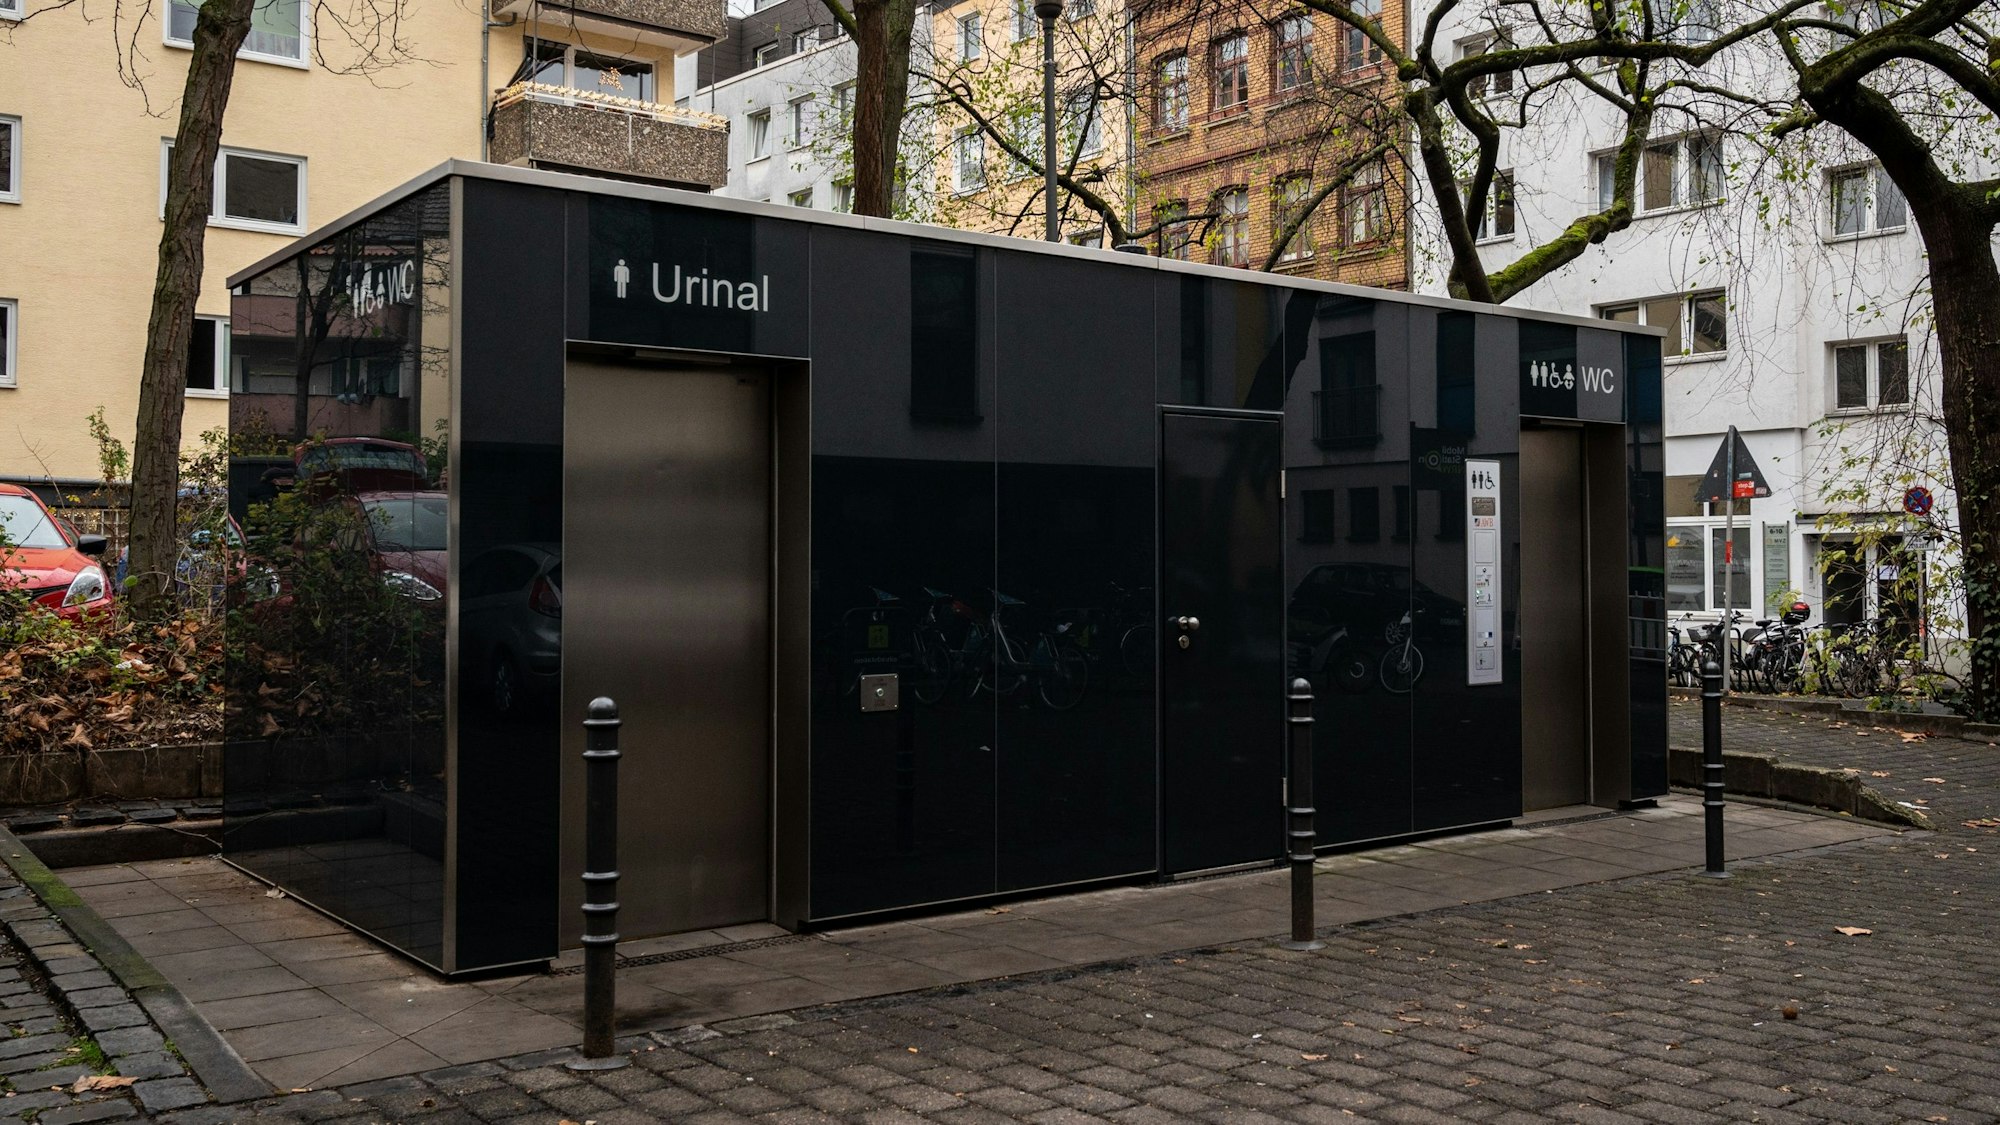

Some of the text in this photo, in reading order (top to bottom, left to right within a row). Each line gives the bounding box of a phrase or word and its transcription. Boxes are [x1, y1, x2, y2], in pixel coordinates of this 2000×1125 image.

[387, 259, 414, 305] WC
[652, 262, 769, 312] Urinal
[1581, 365, 1614, 394] WC
[1480, 518, 1493, 527] AWB
